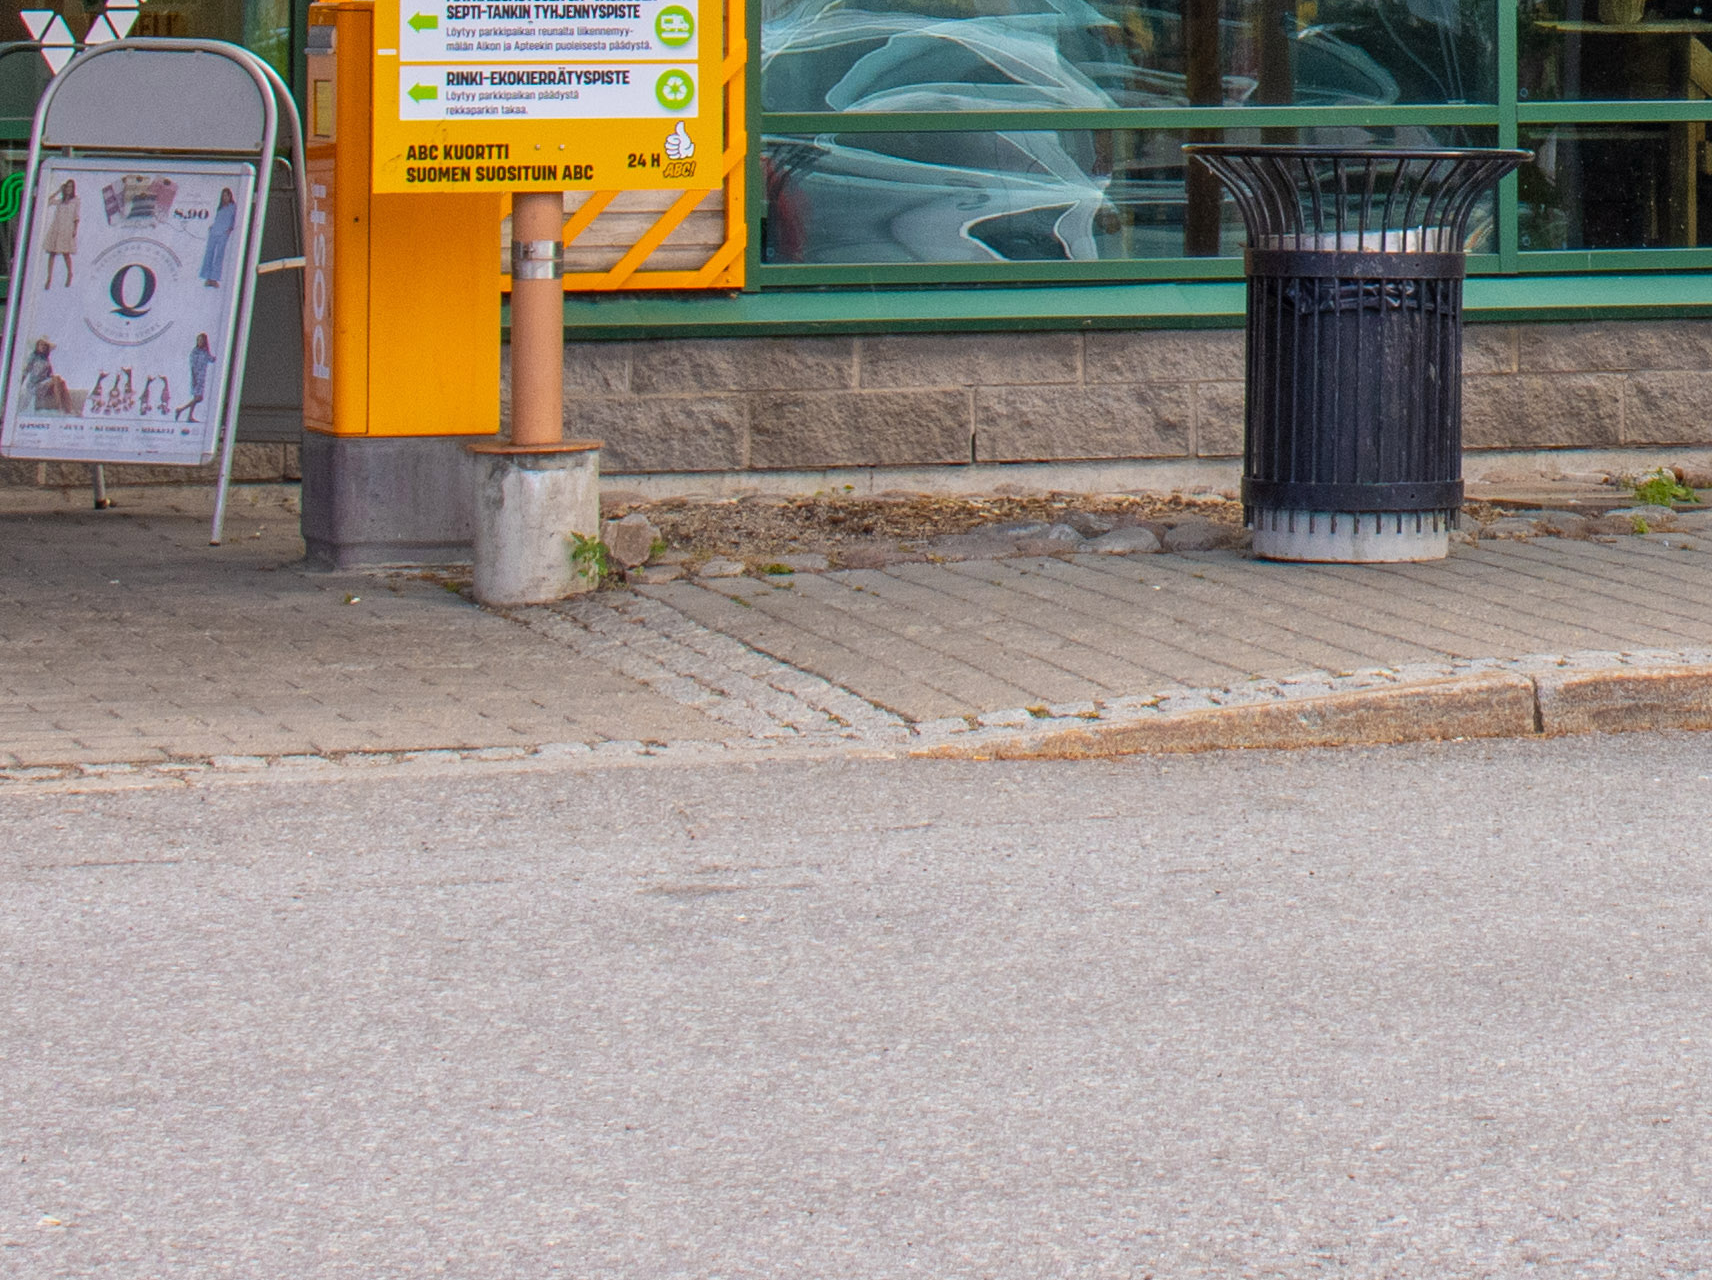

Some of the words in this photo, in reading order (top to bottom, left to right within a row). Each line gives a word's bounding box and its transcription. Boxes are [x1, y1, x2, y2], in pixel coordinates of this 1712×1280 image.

[446, 4, 532, 19] SEPTI-TANKIN
[534, 4, 641, 19] TYHJENNYSPISTE
[446, 27, 477, 38] Löytyy
[479, 27, 536, 38] parkkipaikan
[538, 27, 575, 37] reunalta
[446, 41, 474, 52] mälän
[503, 41, 512, 52] ja
[514, 41, 553, 52] Apteekin
[555, 41, 607, 52] puoleisesta
[446, 67, 630, 86] RINKI-EKOKIERRÄTYSPISTE
[445, 91, 477, 102] Löytyy
[479, 91, 536, 102] parkkipaikan
[538, 90, 580, 101] päädystä
[445, 105, 499, 116] rekkaparkin
[501, 105, 529, 115] takaa.
[406, 144, 439, 161] ABC
[443, 143, 510, 160] KUORTTI
[627, 153, 647, 168] 24
[651, 153, 661, 168] H
[406, 166, 471, 183] SUOMEN
[475, 165, 558, 182] SUOSITUIN
[562, 164, 594, 181] ABC
[663, 160, 697, 178] ABC!
[309, 181, 331, 381] posti
[110, 263, 157, 318] Q
